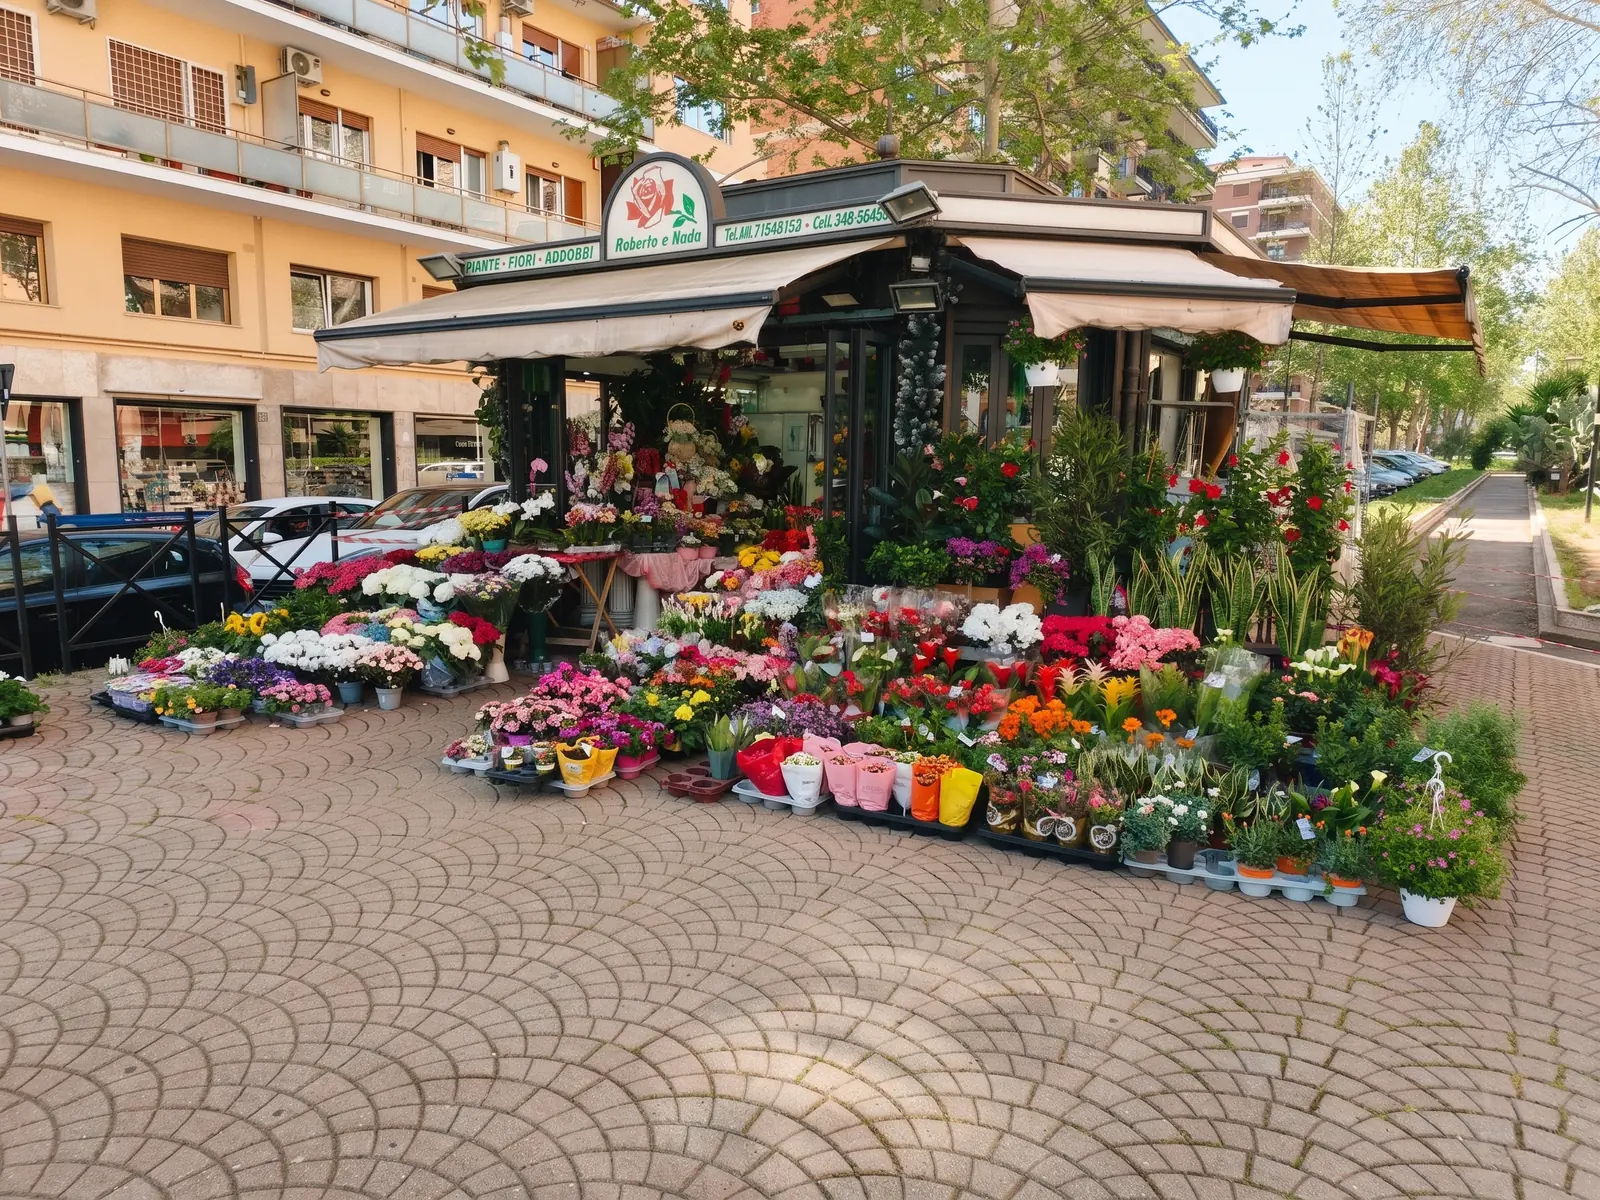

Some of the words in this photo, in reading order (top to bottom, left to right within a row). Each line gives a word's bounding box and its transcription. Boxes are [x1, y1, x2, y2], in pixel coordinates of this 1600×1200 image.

[615, 235, 658, 252] Roberto
[662, 236, 669, 247] e
[672, 228, 702, 245] Nada
[465, 257, 500, 274] PIANTE
[508, 253, 536, 269] FIORI
[545, 245, 594, 264] ADDOBBI
